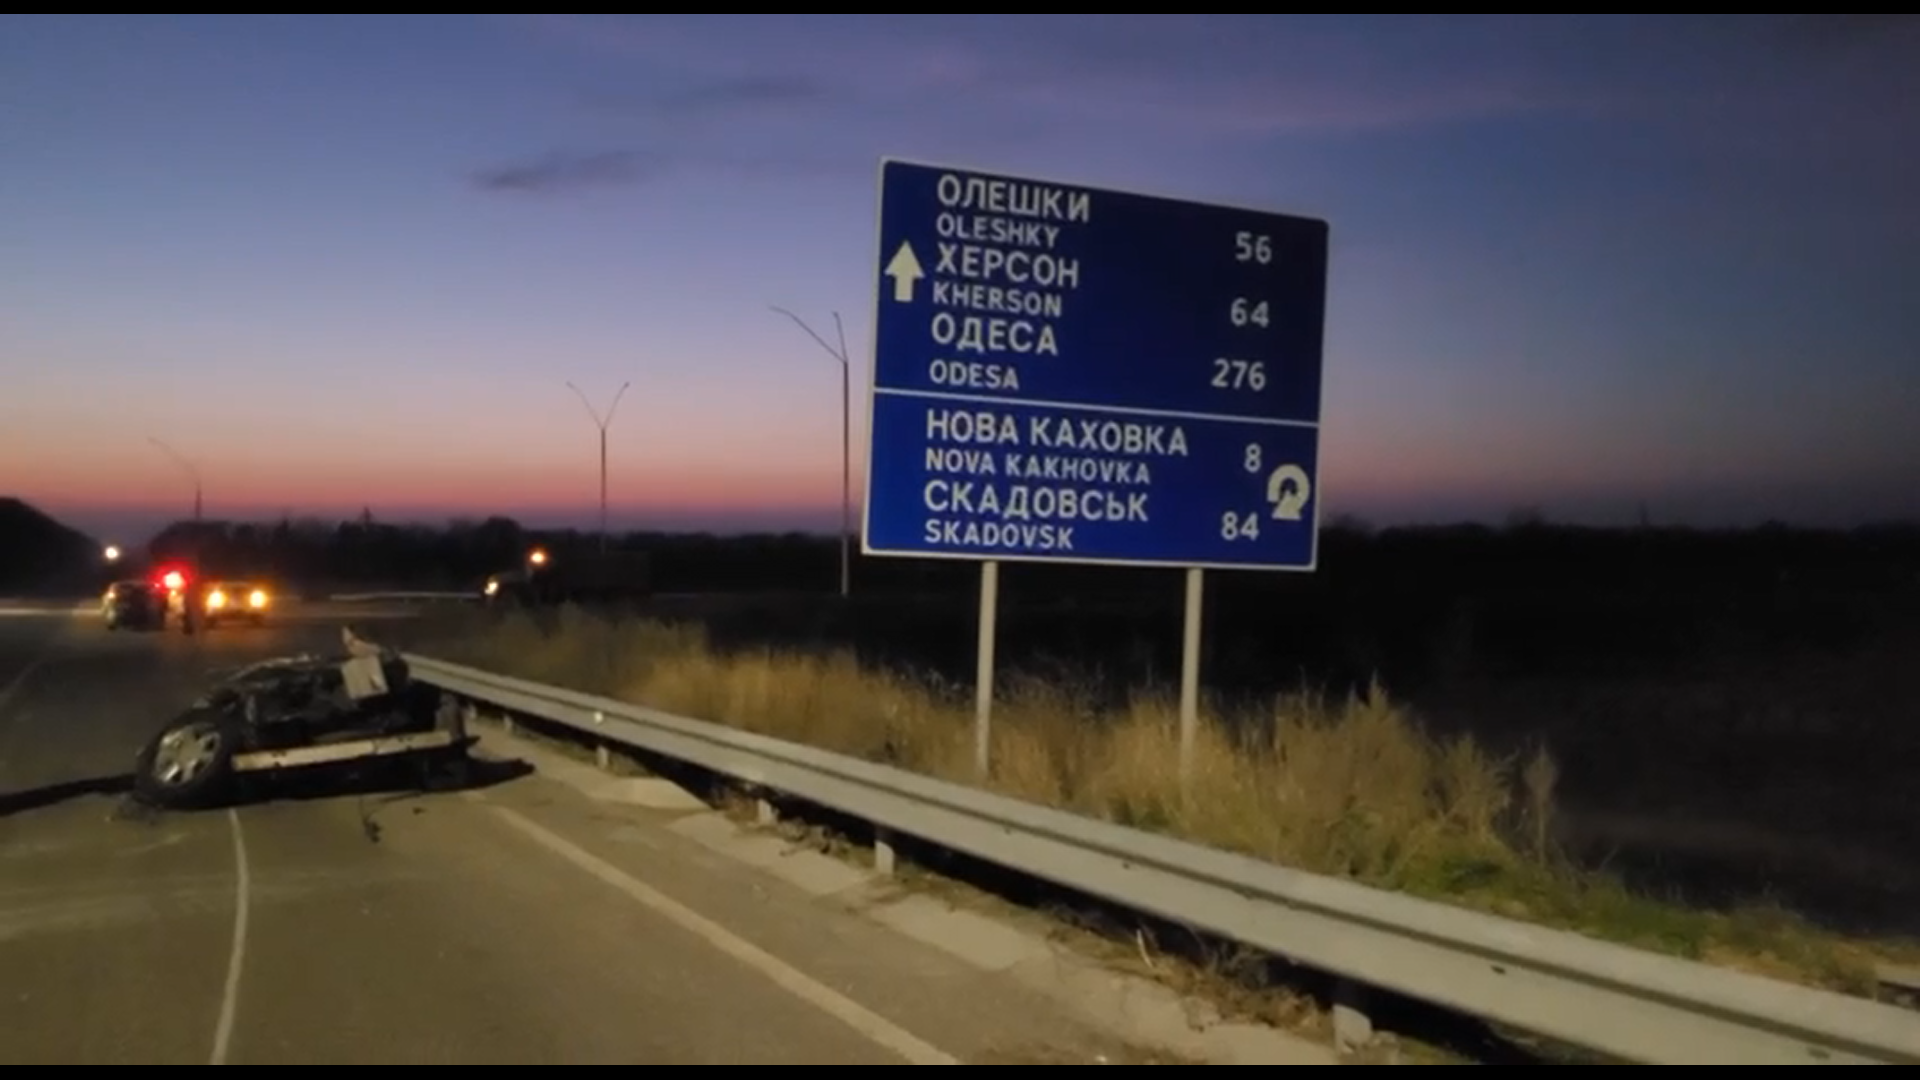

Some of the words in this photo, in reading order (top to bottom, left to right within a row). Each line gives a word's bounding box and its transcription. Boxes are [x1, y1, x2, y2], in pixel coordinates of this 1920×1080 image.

[936, 174, 1091, 222] ОЛЕШКИ
[935, 212, 1060, 248] OLESHKY
[1235, 232, 1273, 263] 56
[934, 242, 1079, 288] ХЕРСОН
[932, 281, 1063, 317] KHERSON
[1230, 298, 1270, 328] 64
[931, 312, 1059, 355] ОДЕСА
[928, 359, 1019, 390] ODESA
[1210, 358, 1267, 391] 276
[926, 408, 1020, 444] НОВА
[1030, 416, 1189, 456] КАХОВКА
[925, 447, 996, 475] NOVA
[1005, 453, 1151, 485] KAKHOVKA
[1244, 443, 1262, 473] 8
[923, 479, 1149, 522] СКАДОВСЬК
[924, 518, 1074, 550] SKADOVSK
[1220, 511, 1260, 541] 84
